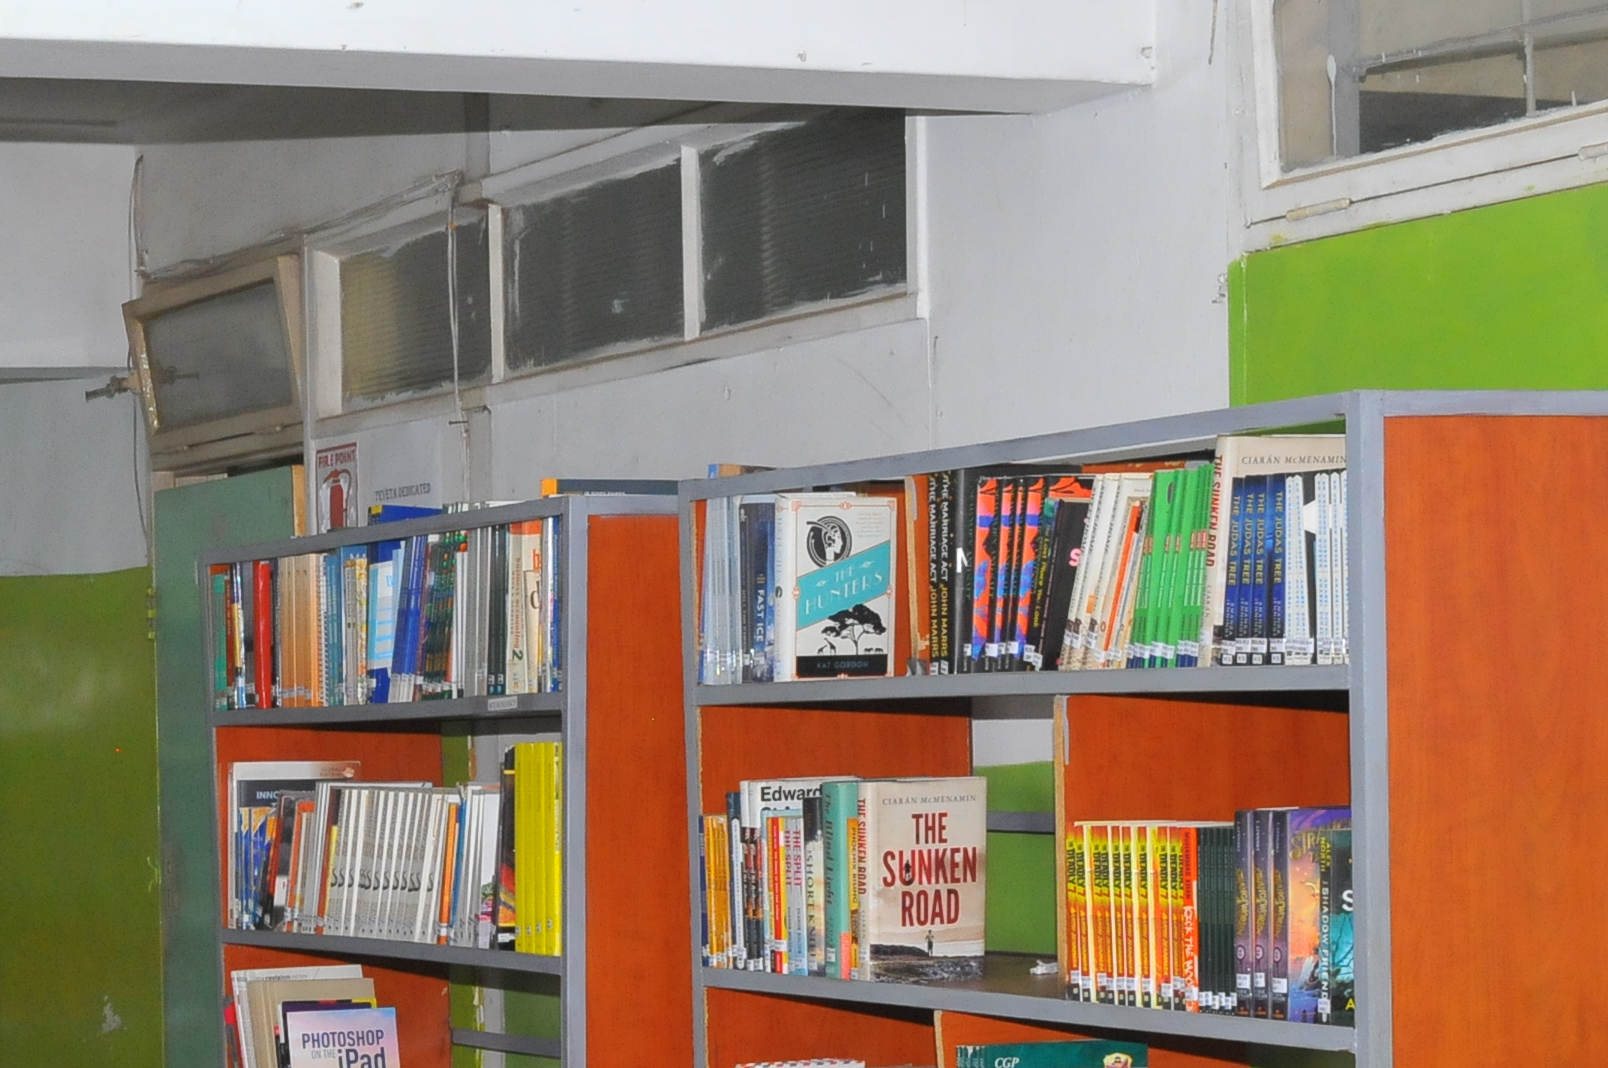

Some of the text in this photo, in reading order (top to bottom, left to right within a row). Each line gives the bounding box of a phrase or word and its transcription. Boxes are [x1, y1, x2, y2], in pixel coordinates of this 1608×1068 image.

[319, 449, 357, 468] FIRE POINT
[375, 482, 431, 501] TEVETA DEDICATED
[1207, 454, 1224, 567] THE SUNKEN ROAD
[1228, 495, 1241, 586] THE JUDAS TREE
[1241, 493, 1254, 584] THE JUDAS TREE
[1254, 493, 1265, 584] THE JUDAS TREE
[1274, 491, 1283, 584] THE JUDAS TREE
[834, 567, 855, 583] THE
[929, 479, 939, 657] THE MARRIAGE ACT JOHN MARRS
[940, 478, 949, 657] THE MARRIAGE ACT JOHN MARRS
[1033, 538, 1050, 628] Last Place Look
[512, 557, 524, 661] business accounting 2
[805, 572, 883, 615] HUNTERS
[755, 590, 765, 643] FAST ICE
[817, 660, 869, 670] KAT GORDON
[760, 786, 822, 802] Edward
[882, 795, 977, 806] CIARÁN McMENAMIN
[825, 820, 834, 861] Blind
[858, 798, 866, 895] THE SUNKEN ROAD
[911, 812, 948, 845] THE
[793, 829, 802, 888] THE SPLIT
[882, 847, 977, 887] SUNKEN
[1066, 849, 1076, 885] DEADLY
[1076, 851, 1085, 888] DEADLY
[1093, 851, 1102, 888] DEADLY
[1100, 852, 1109, 888] DEADLY
[1112, 852, 1122, 889] DEADLY
[1123, 852, 1132, 890] DEADLY
[1139, 853, 1148, 890] DEADLY
[1159, 853, 1168, 891] DEADLY
[1170, 853, 1178, 891] DEADLY
[806, 854, 815, 911] SHORT
[825, 867, 835, 905] Light
[901, 889, 960, 927] ROAD
[1321, 950, 1329, 1000] FRIEND
[301, 1029, 385, 1050] PHOTOSHOP
[311, 1049, 336, 1059] ON THE
[994, 1056, 1020, 1068] CGP
